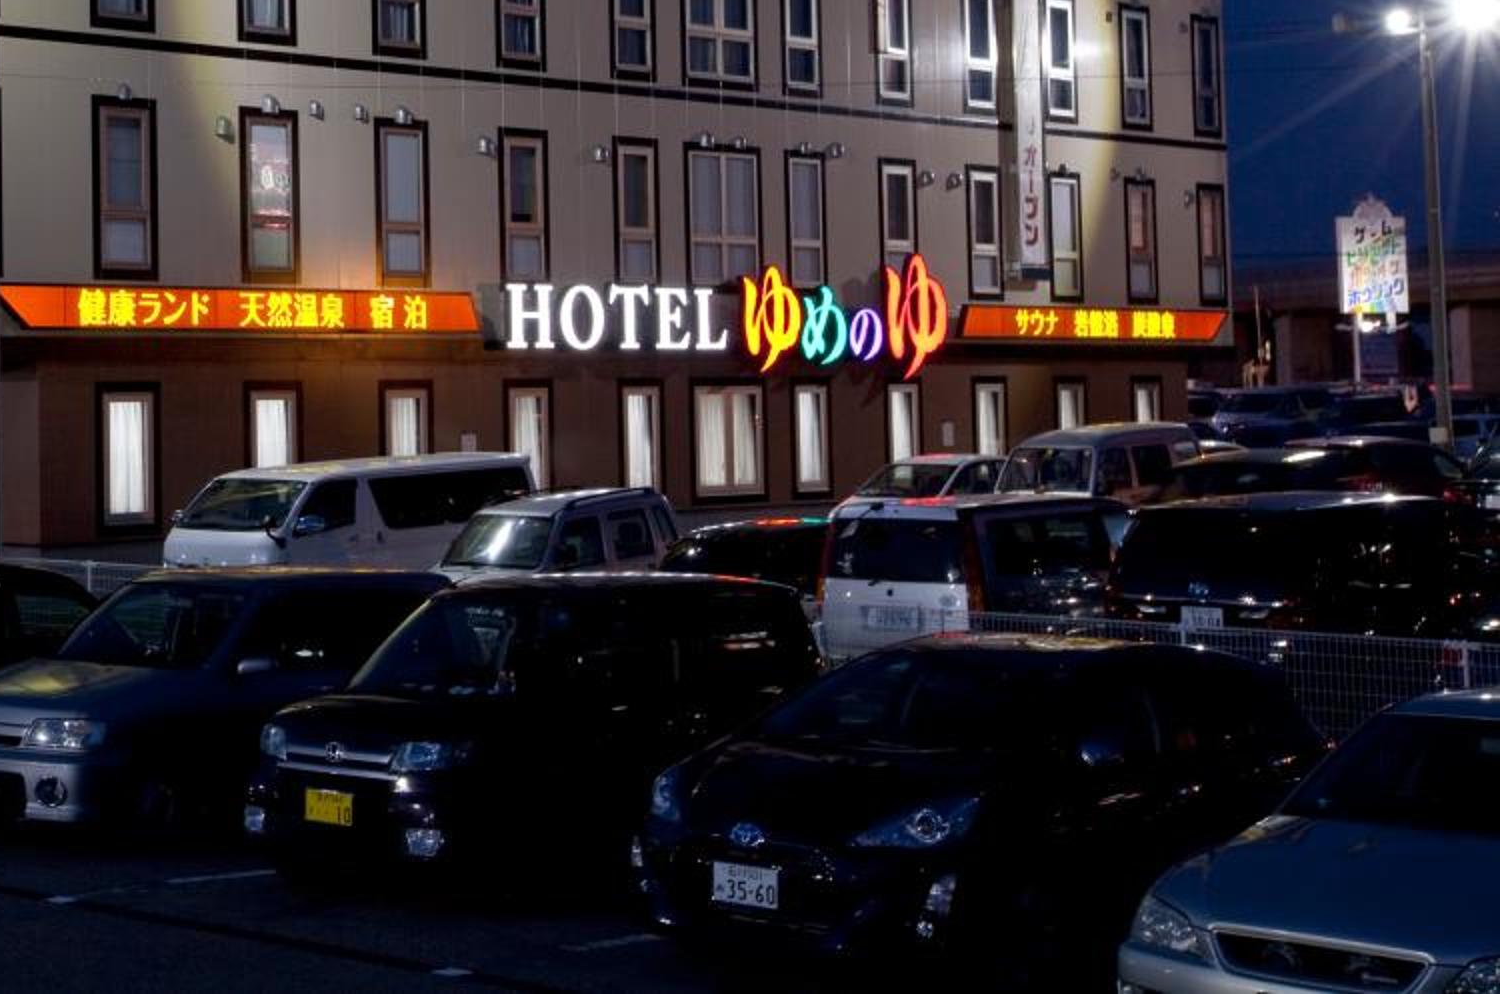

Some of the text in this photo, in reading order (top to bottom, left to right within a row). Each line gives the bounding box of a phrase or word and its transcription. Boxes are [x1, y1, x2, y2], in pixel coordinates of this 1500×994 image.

[78, 288, 210, 327] 健康ランド
[238, 292, 344, 328] 天然温泉
[505, 253, 948, 381] HOTEL ゆめのゆ
[1016, 309, 1058, 335] サウナ
[726, 878, 775, 905] 35-60
